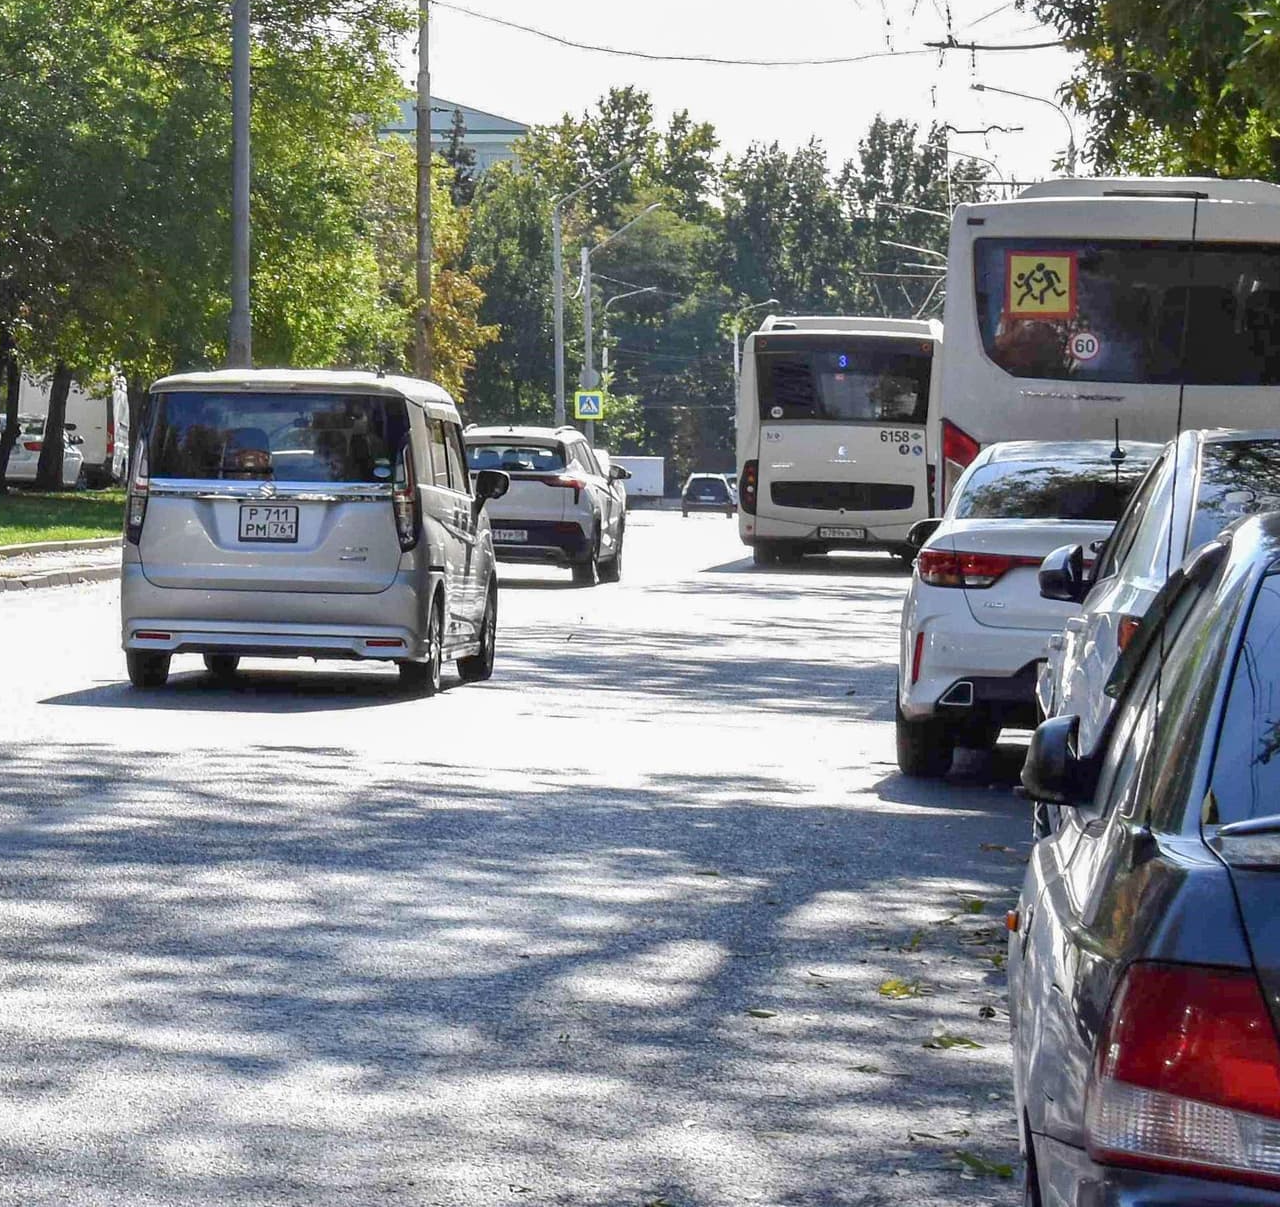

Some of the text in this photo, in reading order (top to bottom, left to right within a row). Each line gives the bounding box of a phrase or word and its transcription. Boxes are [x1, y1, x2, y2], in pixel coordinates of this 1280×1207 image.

[1075, 339, 1095, 353] 60
[839, 354, 848, 368] 3
[880, 430, 910, 443] 6158
[264, 508, 289, 521] 711
[273, 523, 294, 534] 761
